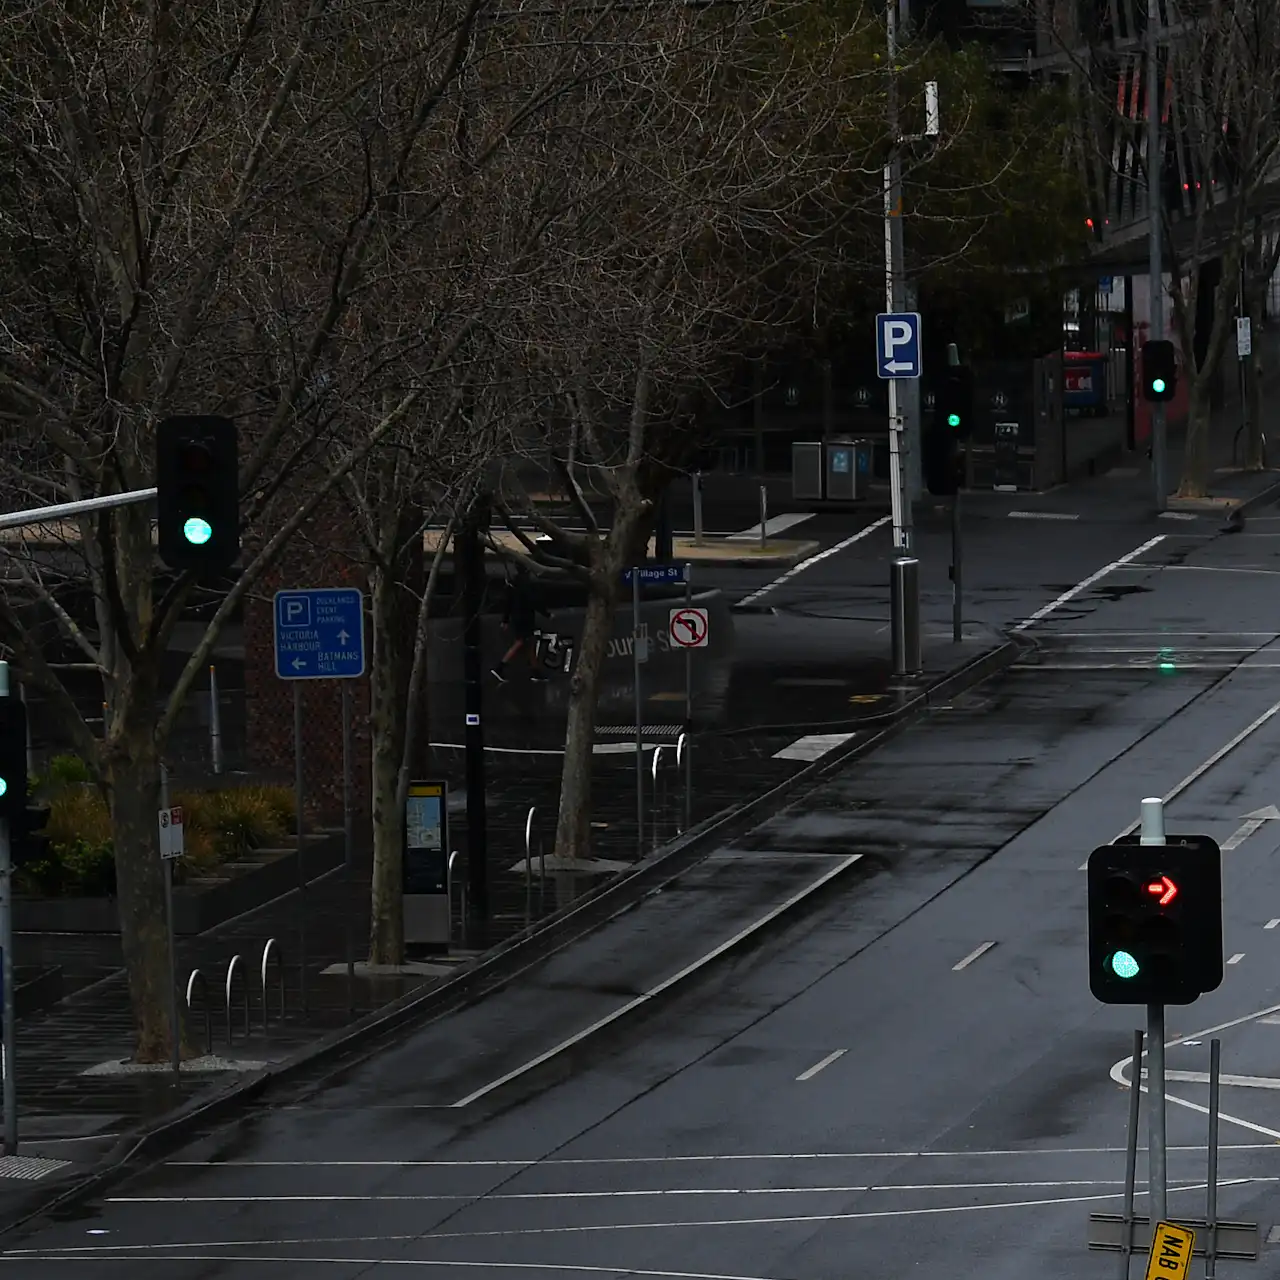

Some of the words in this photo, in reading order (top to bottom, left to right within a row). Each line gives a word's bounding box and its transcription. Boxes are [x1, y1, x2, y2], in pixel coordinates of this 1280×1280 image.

[884, 320, 913, 358] P
[667, 567, 678, 577] St
[287, 602, 303, 622] P
[280, 630, 319, 641] VICTORIA
[280, 641, 321, 652] HARBOUR
[317, 650, 360, 661] BATMANS
[317, 661, 338, 672] HILL
[1158, 1234, 1184, 1272] NAB
